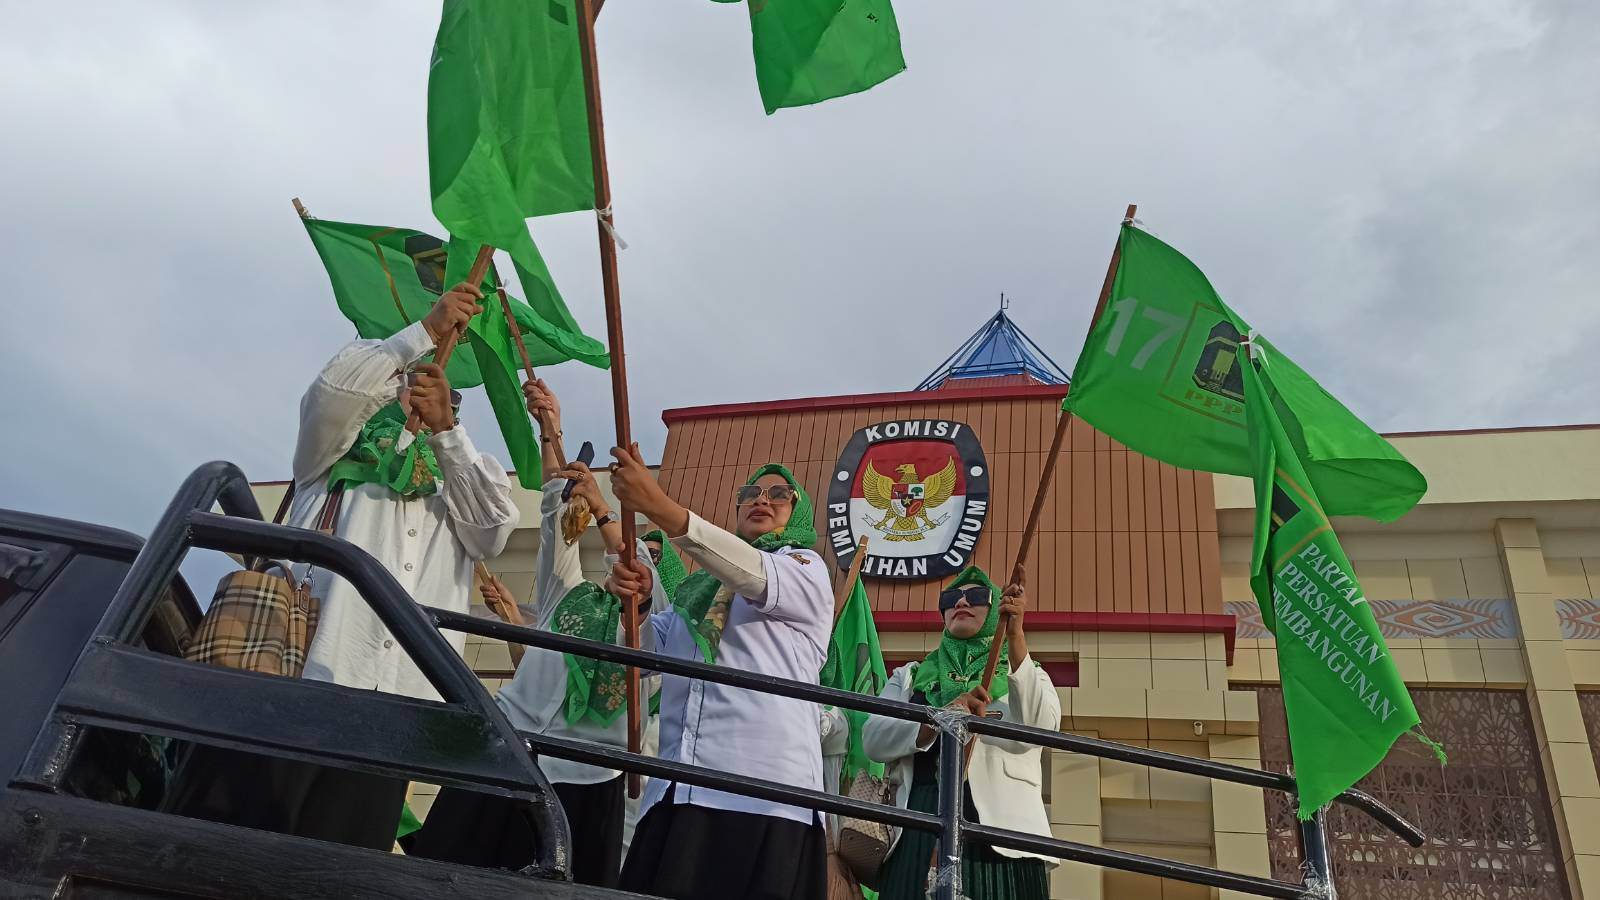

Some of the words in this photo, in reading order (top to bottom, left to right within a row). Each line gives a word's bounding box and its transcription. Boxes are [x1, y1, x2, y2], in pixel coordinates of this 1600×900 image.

[1104, 296, 1187, 371] 17
[865, 421, 961, 442] KOMISI
[1184, 389, 1243, 415] PPP
[829, 502, 928, 576] PEMIIHAN
[943, 500, 987, 567] UMUM
[1299, 542, 1367, 607] PARTAI
[1277, 561, 1386, 666] PERSATUAN
